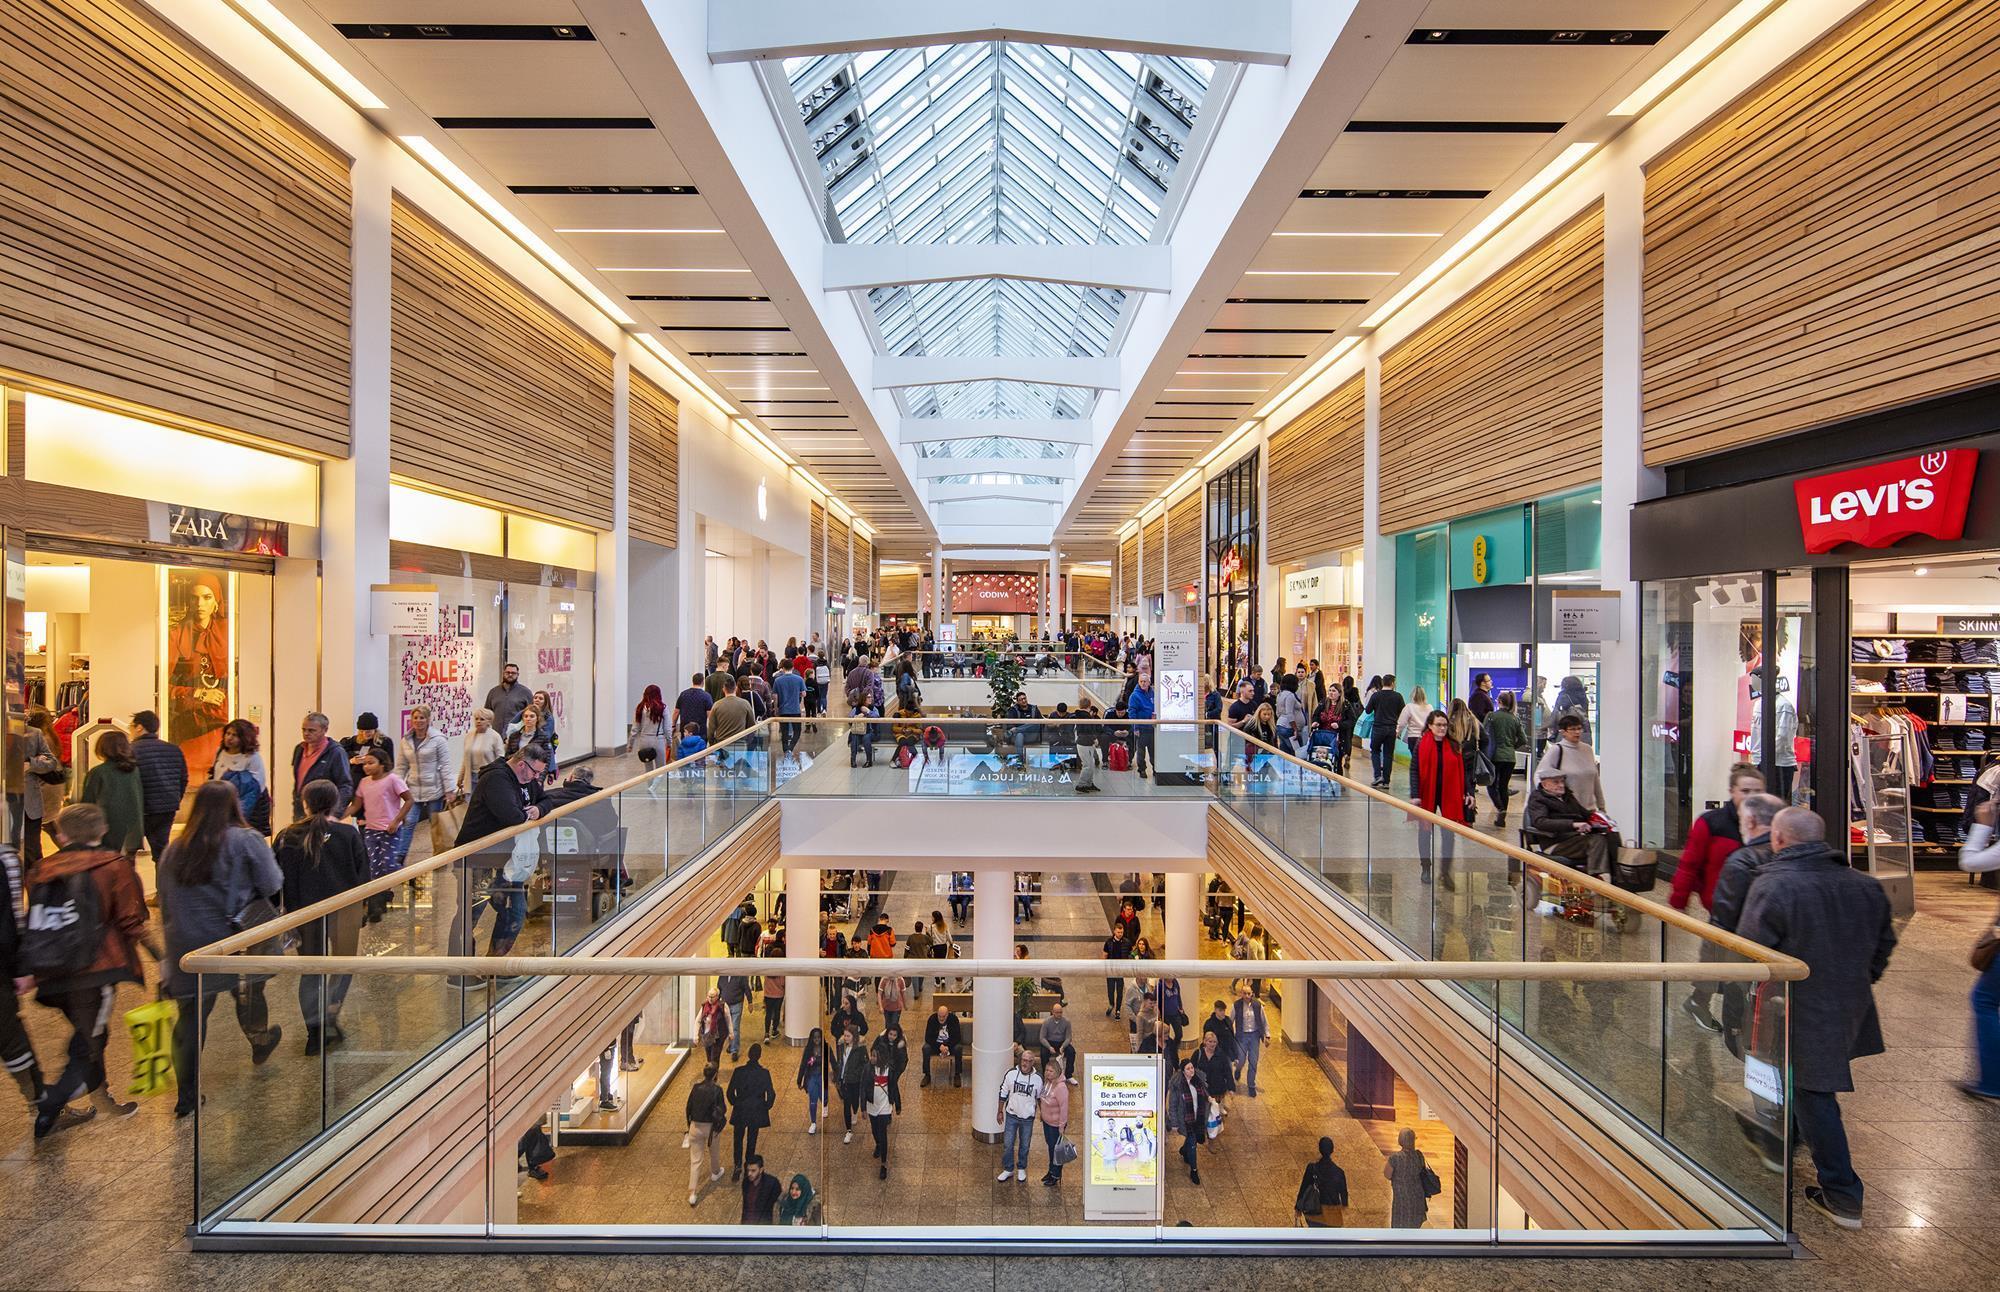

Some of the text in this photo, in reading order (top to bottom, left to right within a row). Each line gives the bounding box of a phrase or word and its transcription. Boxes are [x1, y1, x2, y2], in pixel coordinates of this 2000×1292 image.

[171, 513, 229, 541] ZARA
[980, 591, 1009, 599] GODIVA
[1959, 620, 2000, 632] SKINN
[538, 648, 571, 674] SALE
[417, 660, 458, 685] SALE
[1242, 773, 1272, 782] LUCIA
